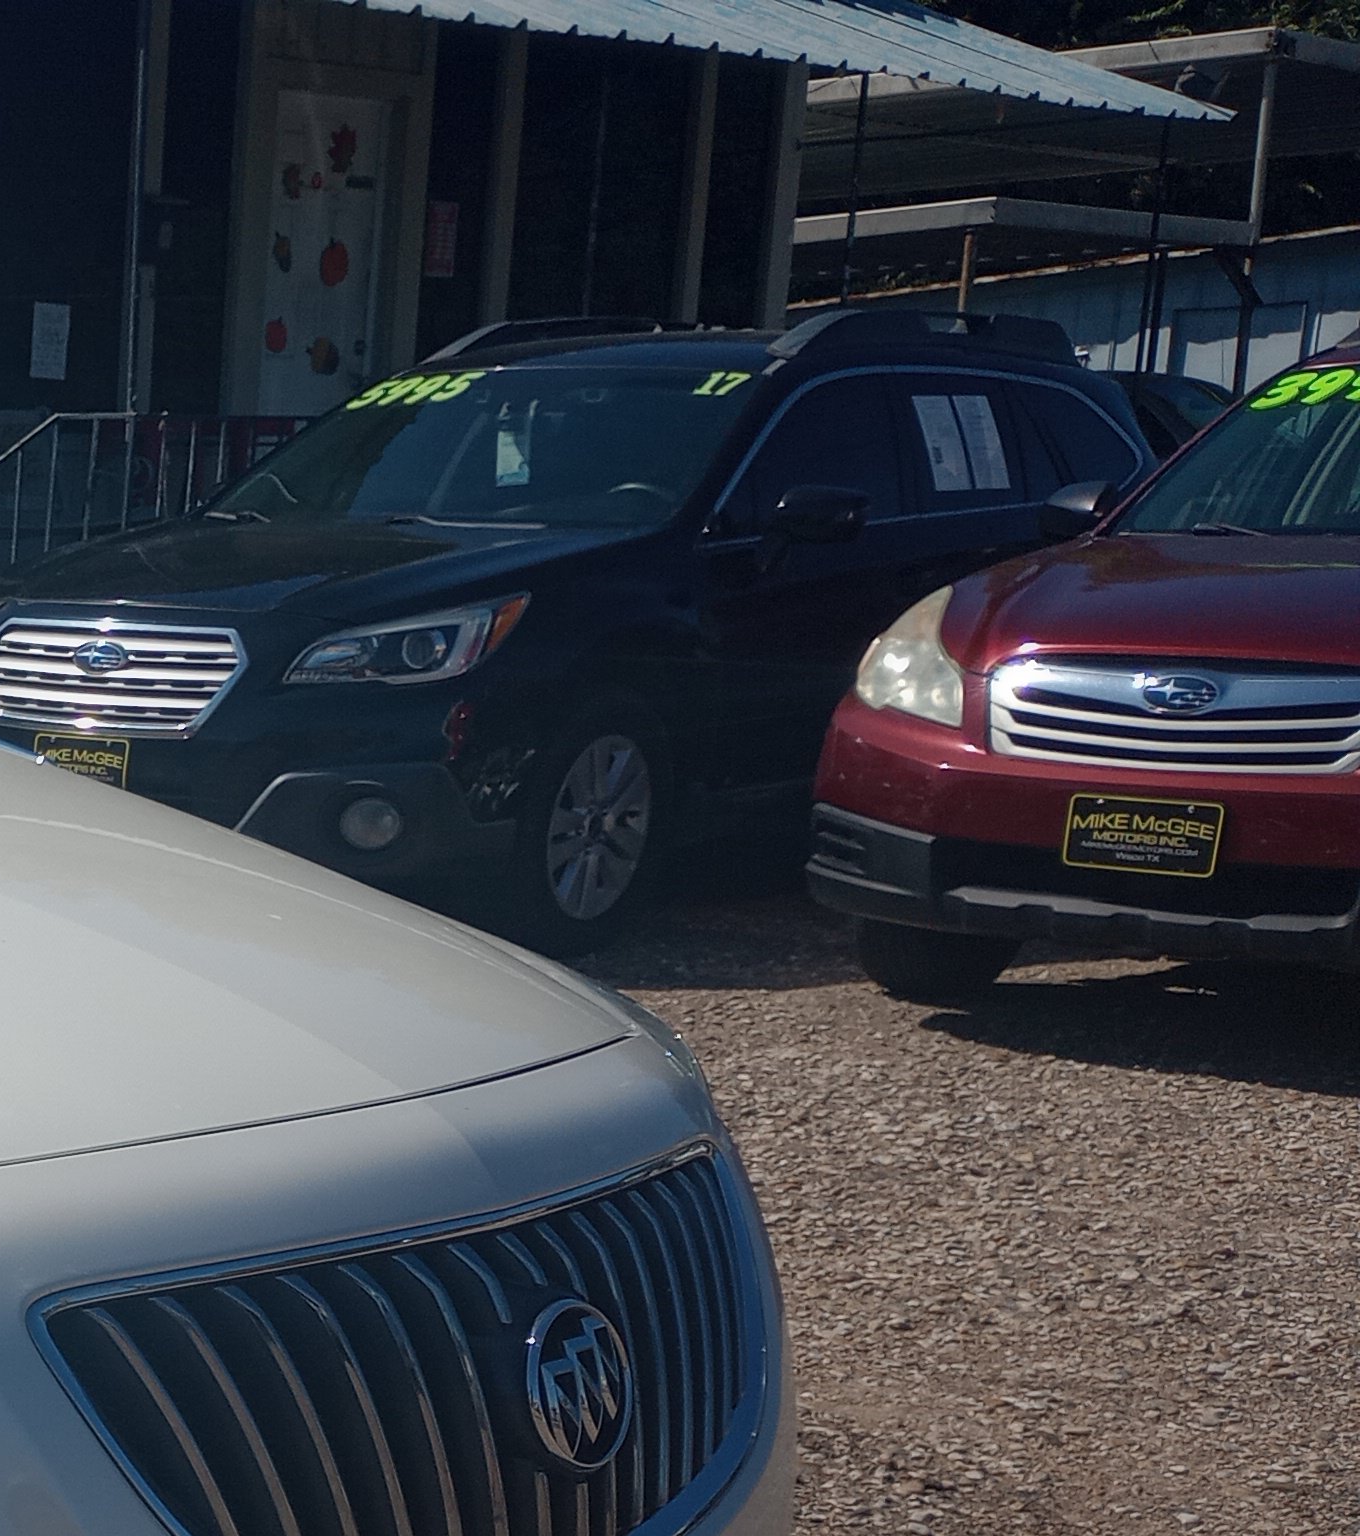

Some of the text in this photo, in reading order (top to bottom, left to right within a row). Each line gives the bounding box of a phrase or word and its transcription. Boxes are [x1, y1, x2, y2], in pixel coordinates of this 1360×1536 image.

[346, 371, 487, 411] 5995
[693, 371, 752, 396] 17
[1249, 368, 1360, 410] 39
[73, 750, 123, 769] McGEE
[1073, 813, 1215, 841] MIKE McGEE
[1092, 830, 1157, 845] MOTORS
